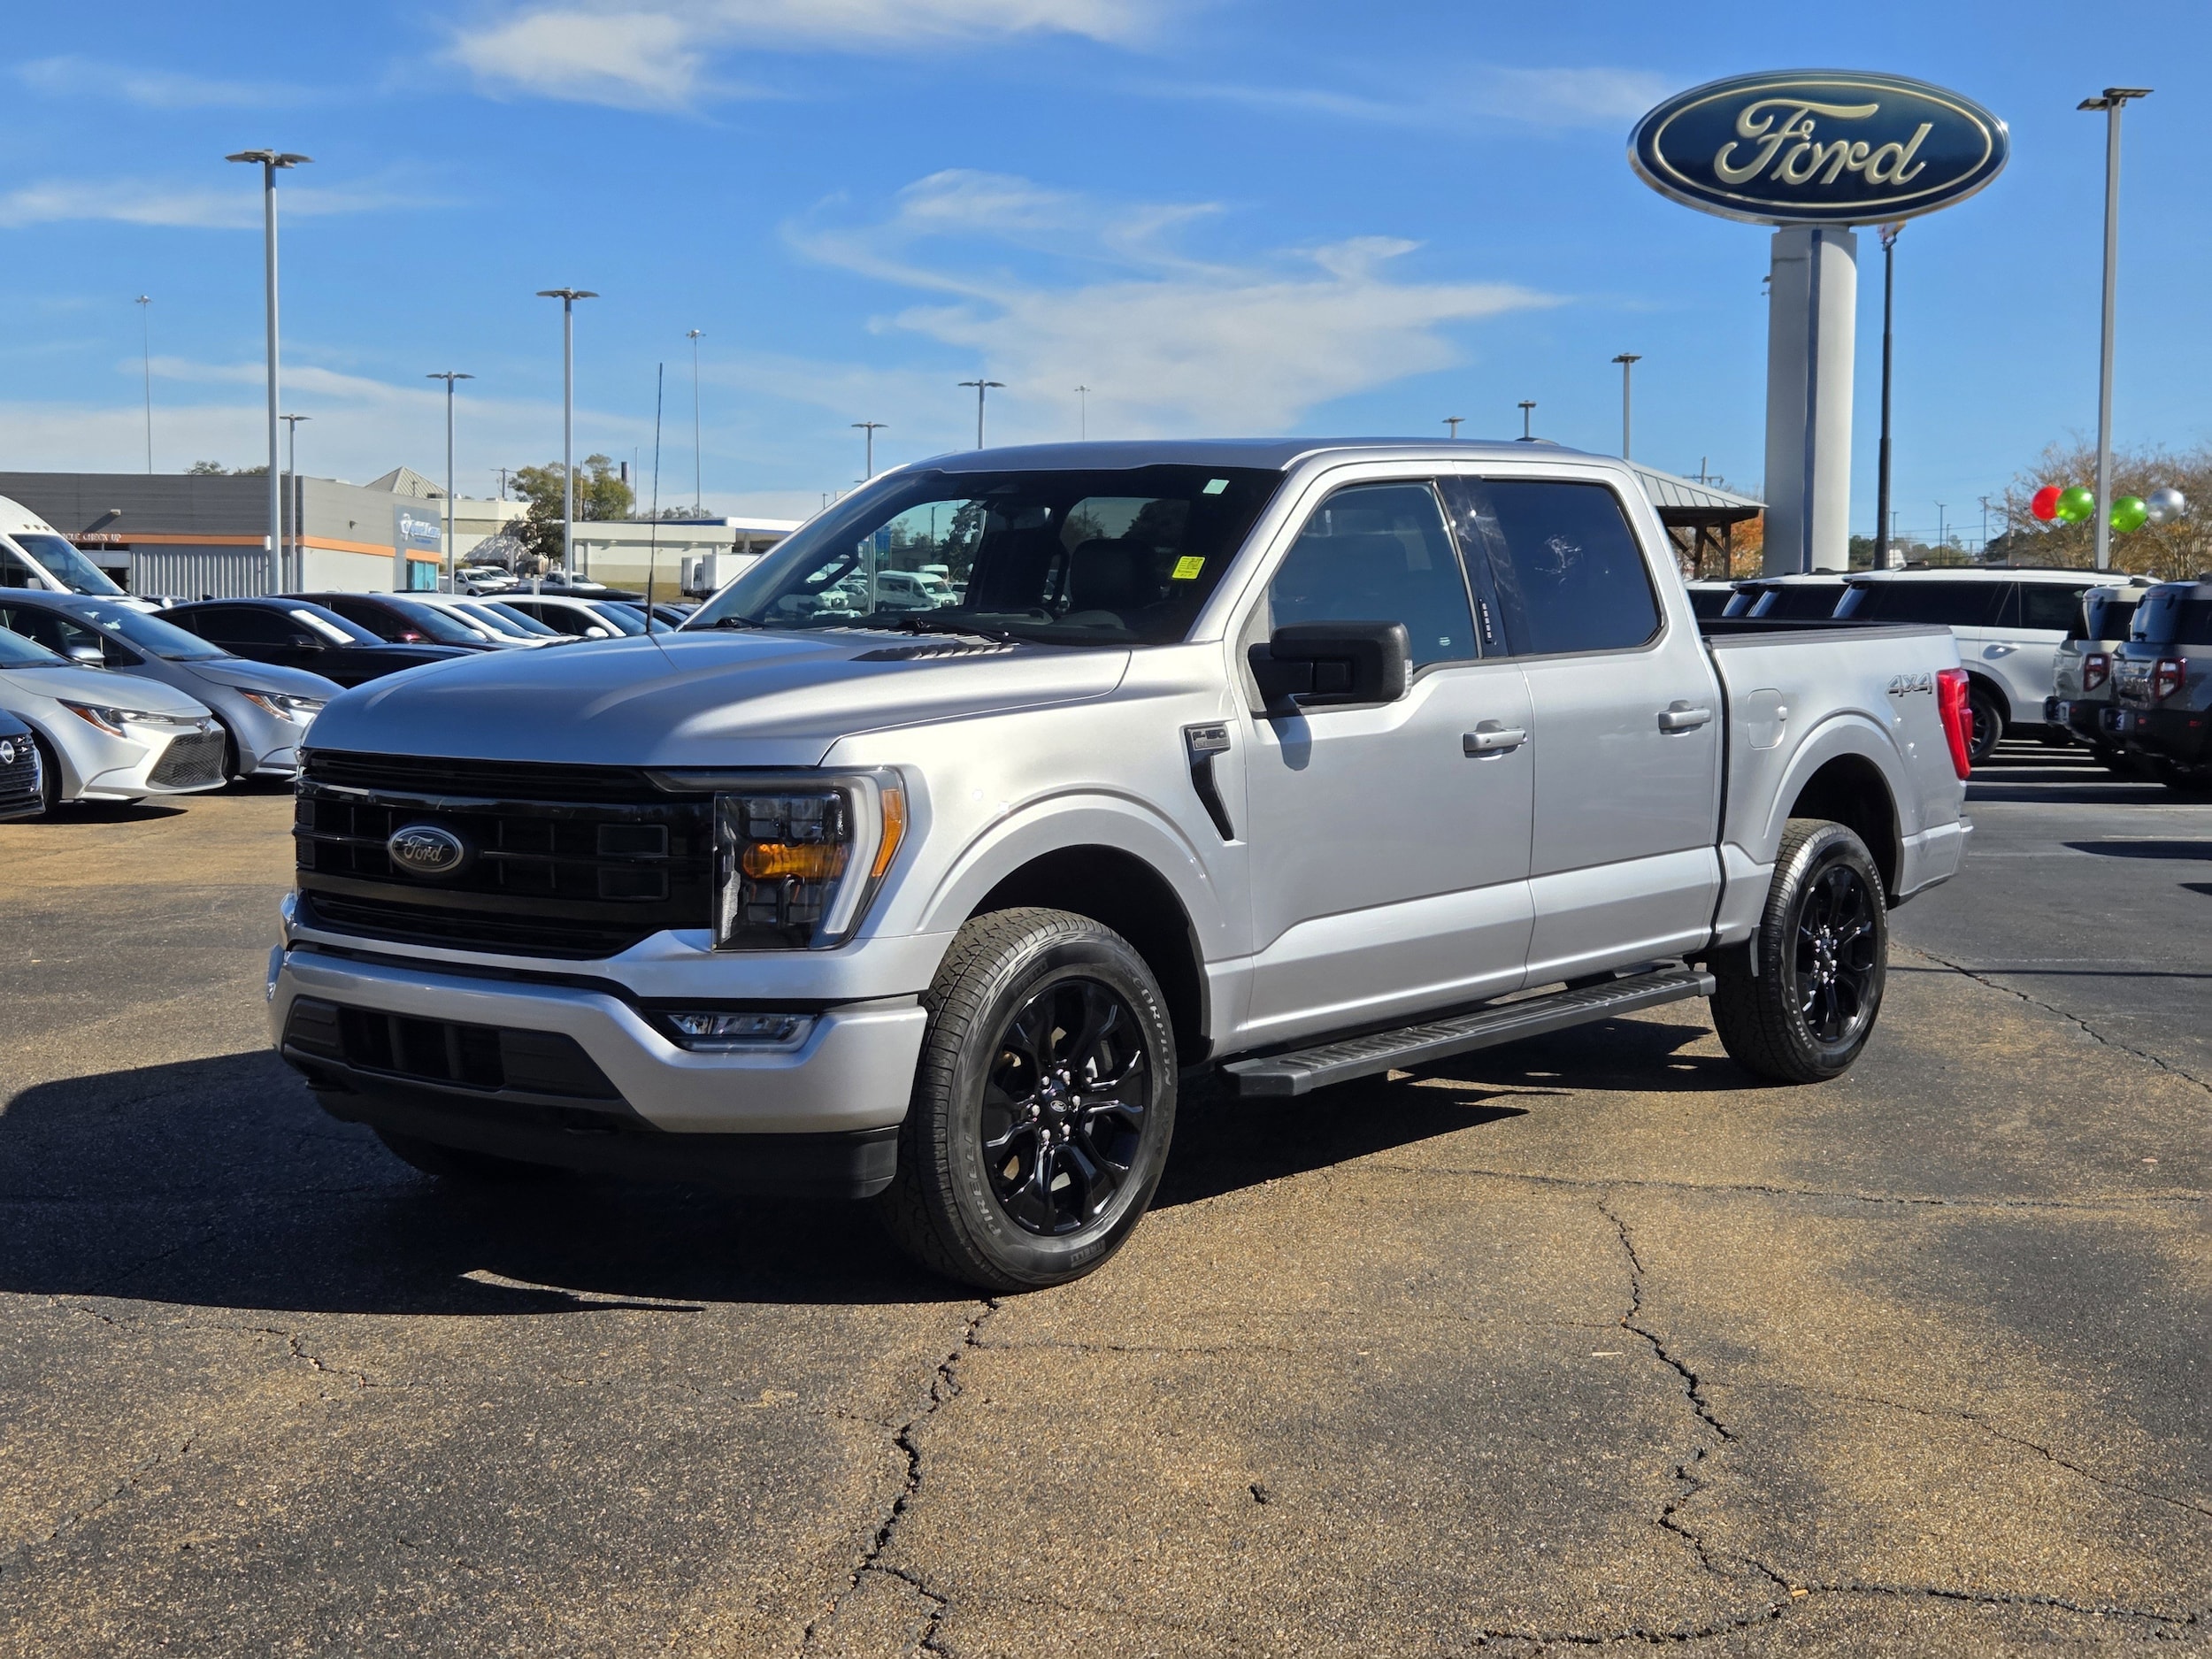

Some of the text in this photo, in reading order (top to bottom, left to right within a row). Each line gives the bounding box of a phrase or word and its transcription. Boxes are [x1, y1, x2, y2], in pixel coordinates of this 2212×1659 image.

[1714, 98, 1933, 185] Ford
[82, 533, 108, 541] CHECK
[111, 534, 121, 542] UP
[1192, 728, 1227, 741] F-150
[403, 835, 444, 862] Ford
[964, 1133, 1002, 1235] PIRELLI
